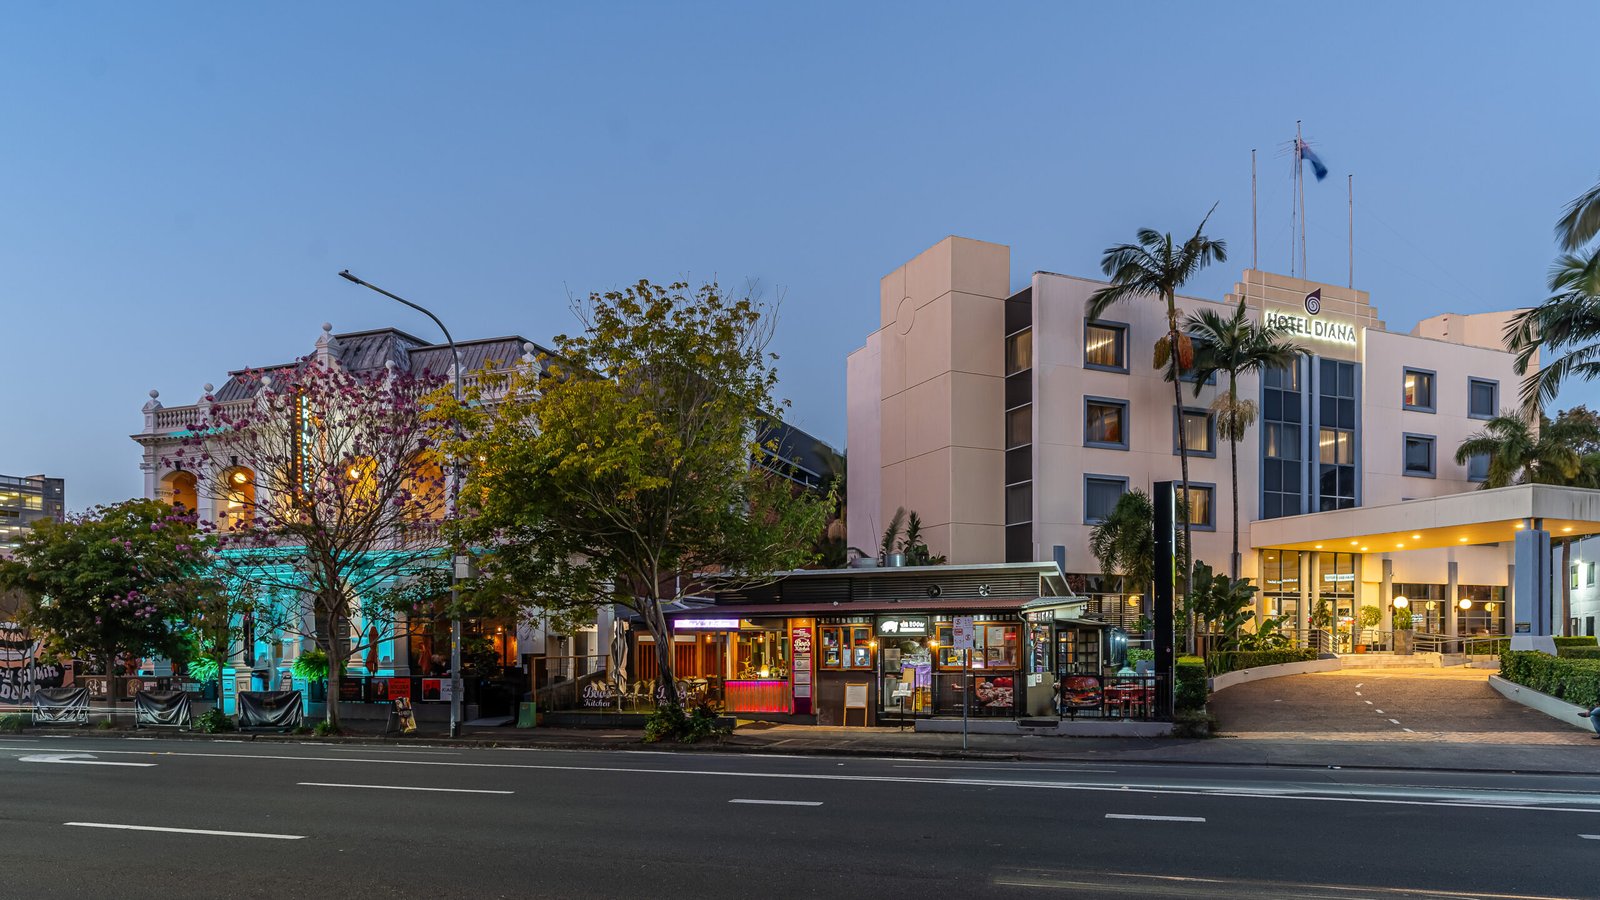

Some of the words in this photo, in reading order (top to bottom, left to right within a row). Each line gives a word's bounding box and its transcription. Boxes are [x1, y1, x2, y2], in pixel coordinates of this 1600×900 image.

[1267, 312, 1311, 335] HOTEL
[1314, 321, 1356, 342] DIANA
[583, 685, 612, 699] Boo's
[584, 699, 611, 707] Kitchen
